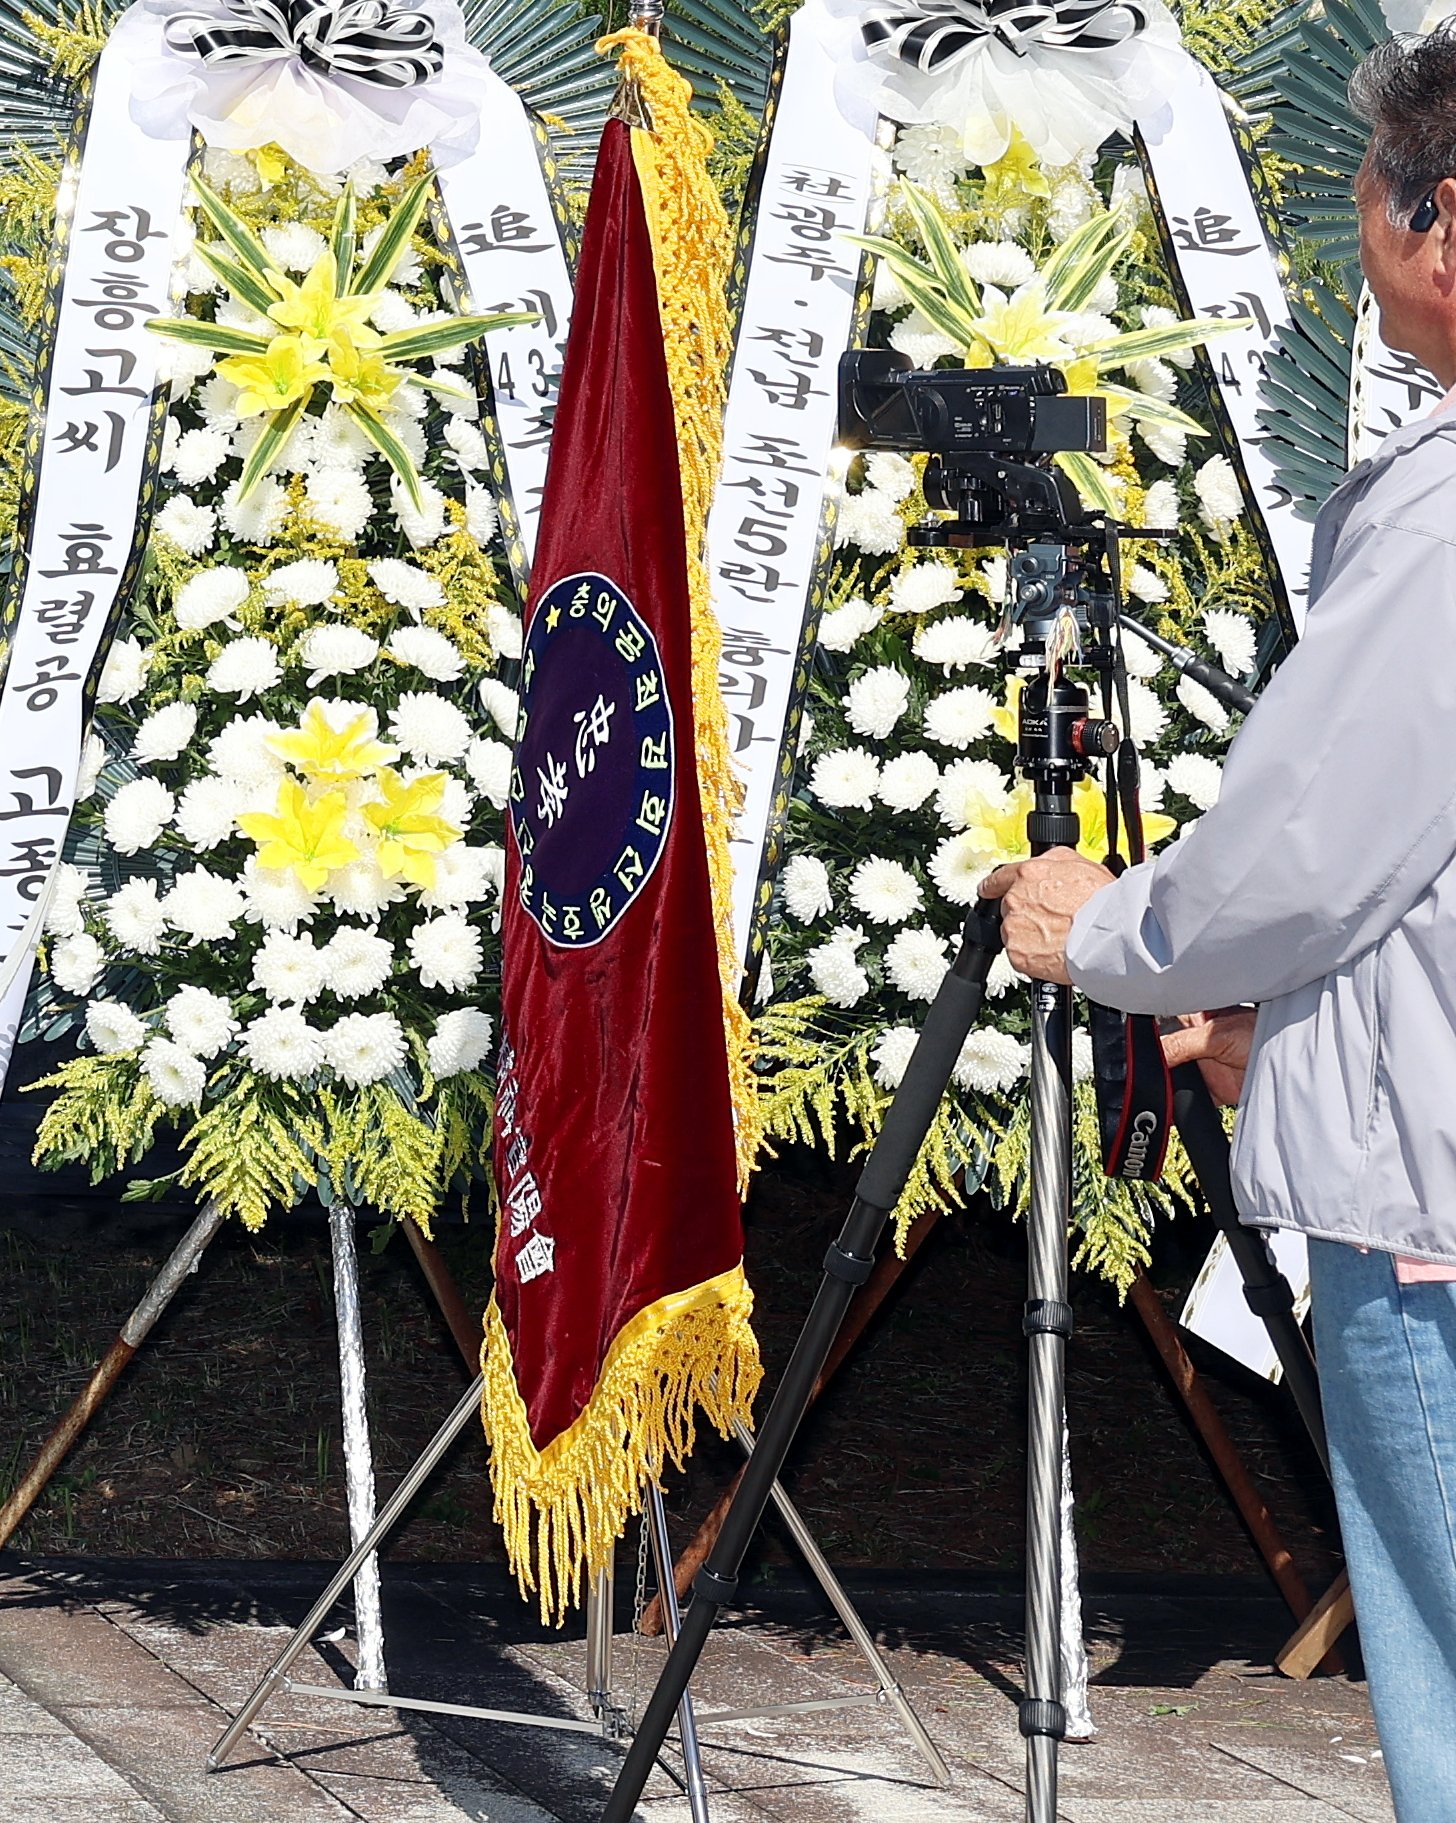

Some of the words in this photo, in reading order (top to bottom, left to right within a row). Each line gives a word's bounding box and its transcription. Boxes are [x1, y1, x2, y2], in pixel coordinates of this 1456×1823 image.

[458, 204, 556, 255] 追
[1172, 206, 1262, 257] 追
[52, 205, 169, 474] 장흥고씨
[1122, 1110, 1158, 1178] Canon
